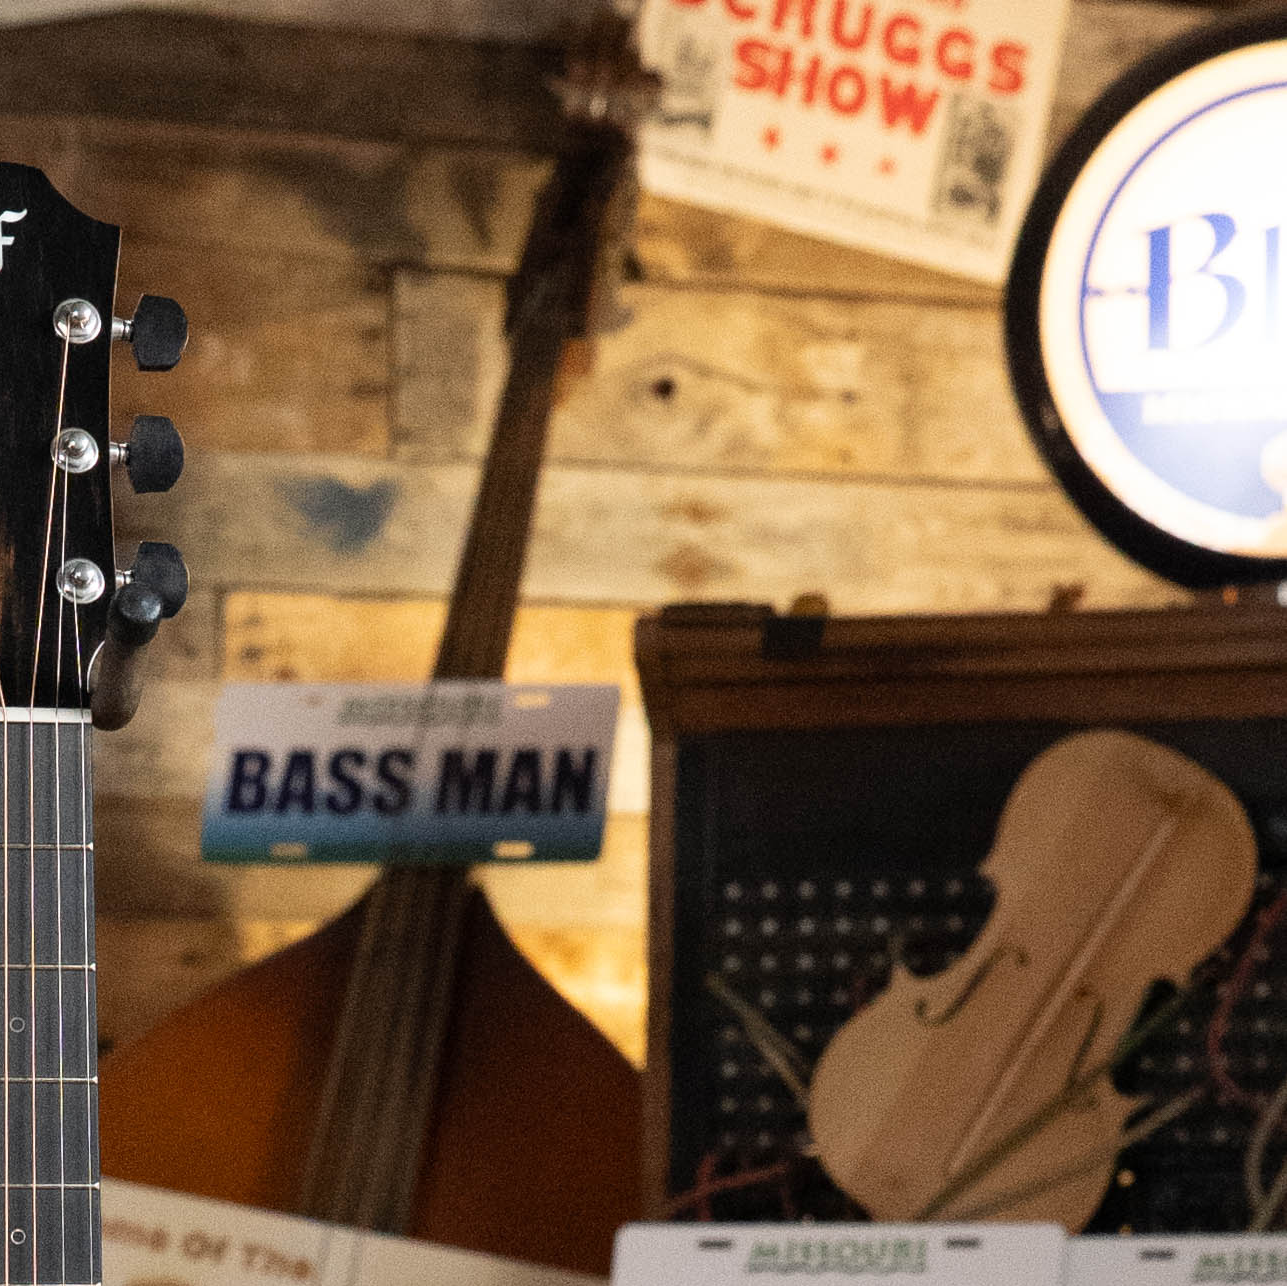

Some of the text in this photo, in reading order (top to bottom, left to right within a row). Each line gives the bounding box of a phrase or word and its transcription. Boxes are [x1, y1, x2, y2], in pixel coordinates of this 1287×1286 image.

[734, 38, 939, 136] SHOW
[226, 747, 598, 815] BASS MAN
